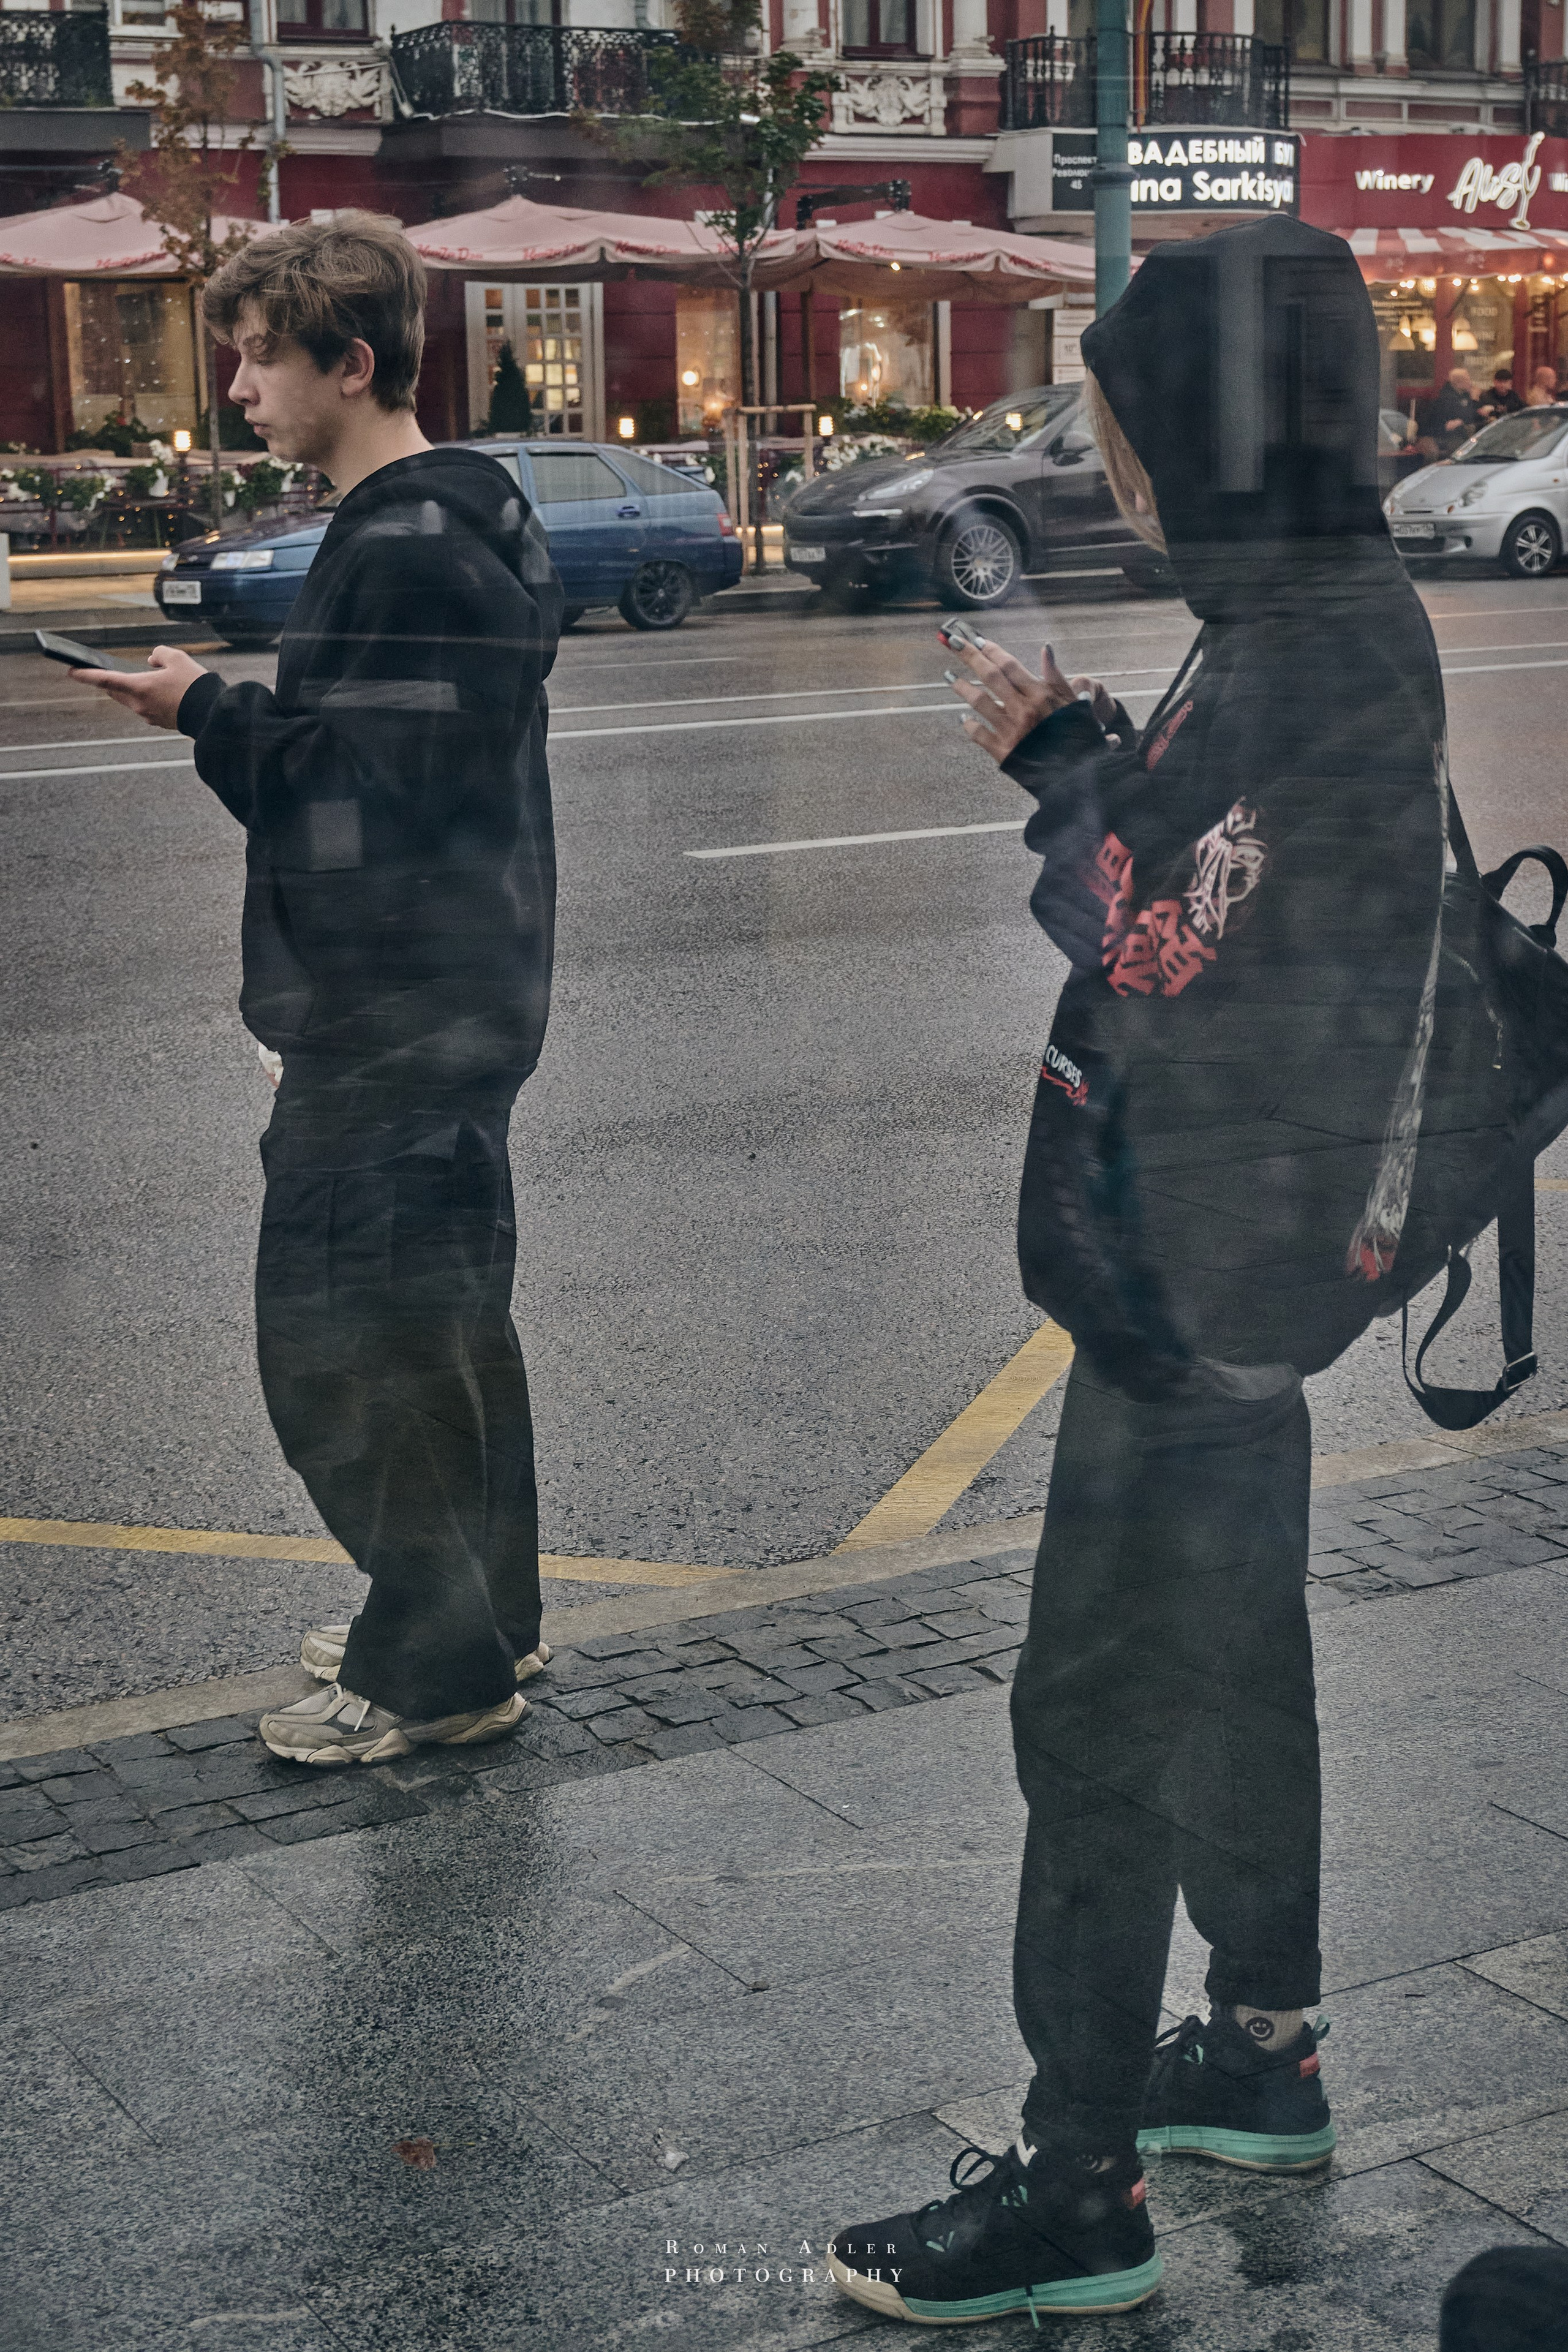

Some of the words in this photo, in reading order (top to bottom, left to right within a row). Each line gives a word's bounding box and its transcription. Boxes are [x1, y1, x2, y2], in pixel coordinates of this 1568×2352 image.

[1128, 136, 1265, 166] ВАДЕБНЫЙ
[1193, 171, 1294, 208] Sarkisya
[1355, 170, 1434, 194] Winery
[1046, 1044, 1082, 1088] CURSES
